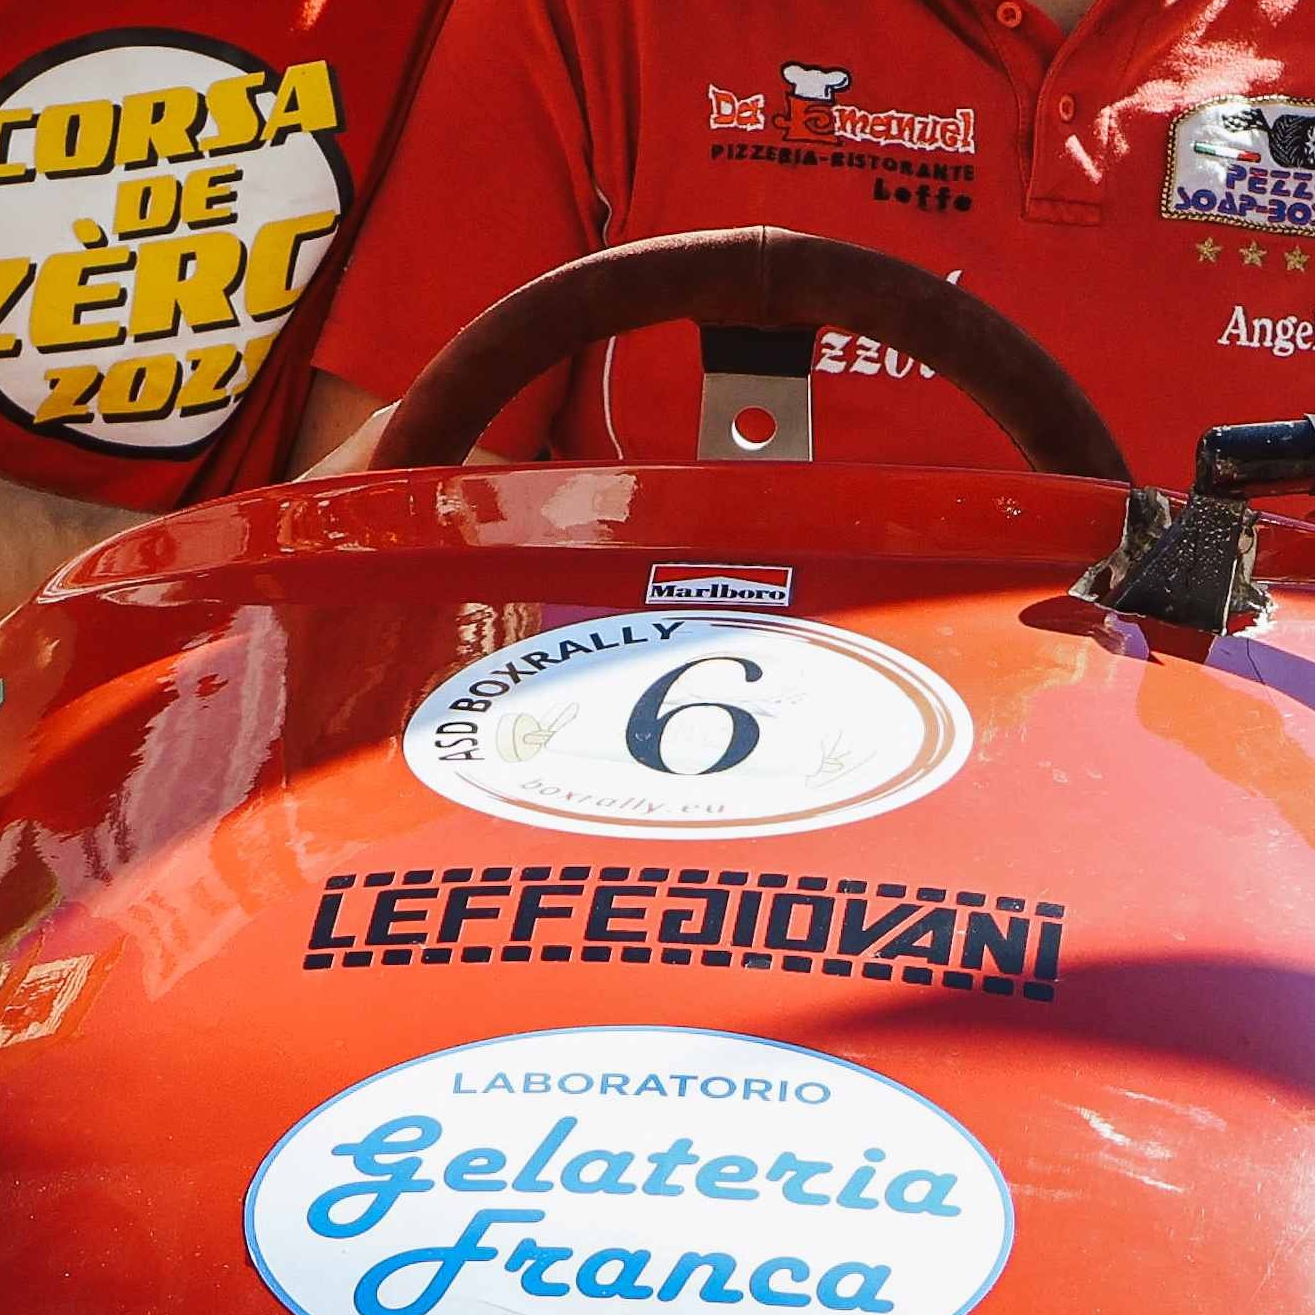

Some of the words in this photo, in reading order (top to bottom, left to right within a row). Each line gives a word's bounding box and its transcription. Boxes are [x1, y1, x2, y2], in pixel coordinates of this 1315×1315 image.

[708, 84, 765, 131] Da
[113, 163, 244, 241] DE
[649, 580, 787, 601] Marlboro
[449, 620, 685, 714] BOXRALLY
[435, 721, 486, 762] ASD
[625, 656, 764, 776] 6
[452, 1070, 831, 1105] LABORATORIO
[306, 1114, 961, 1239] Gelateria
